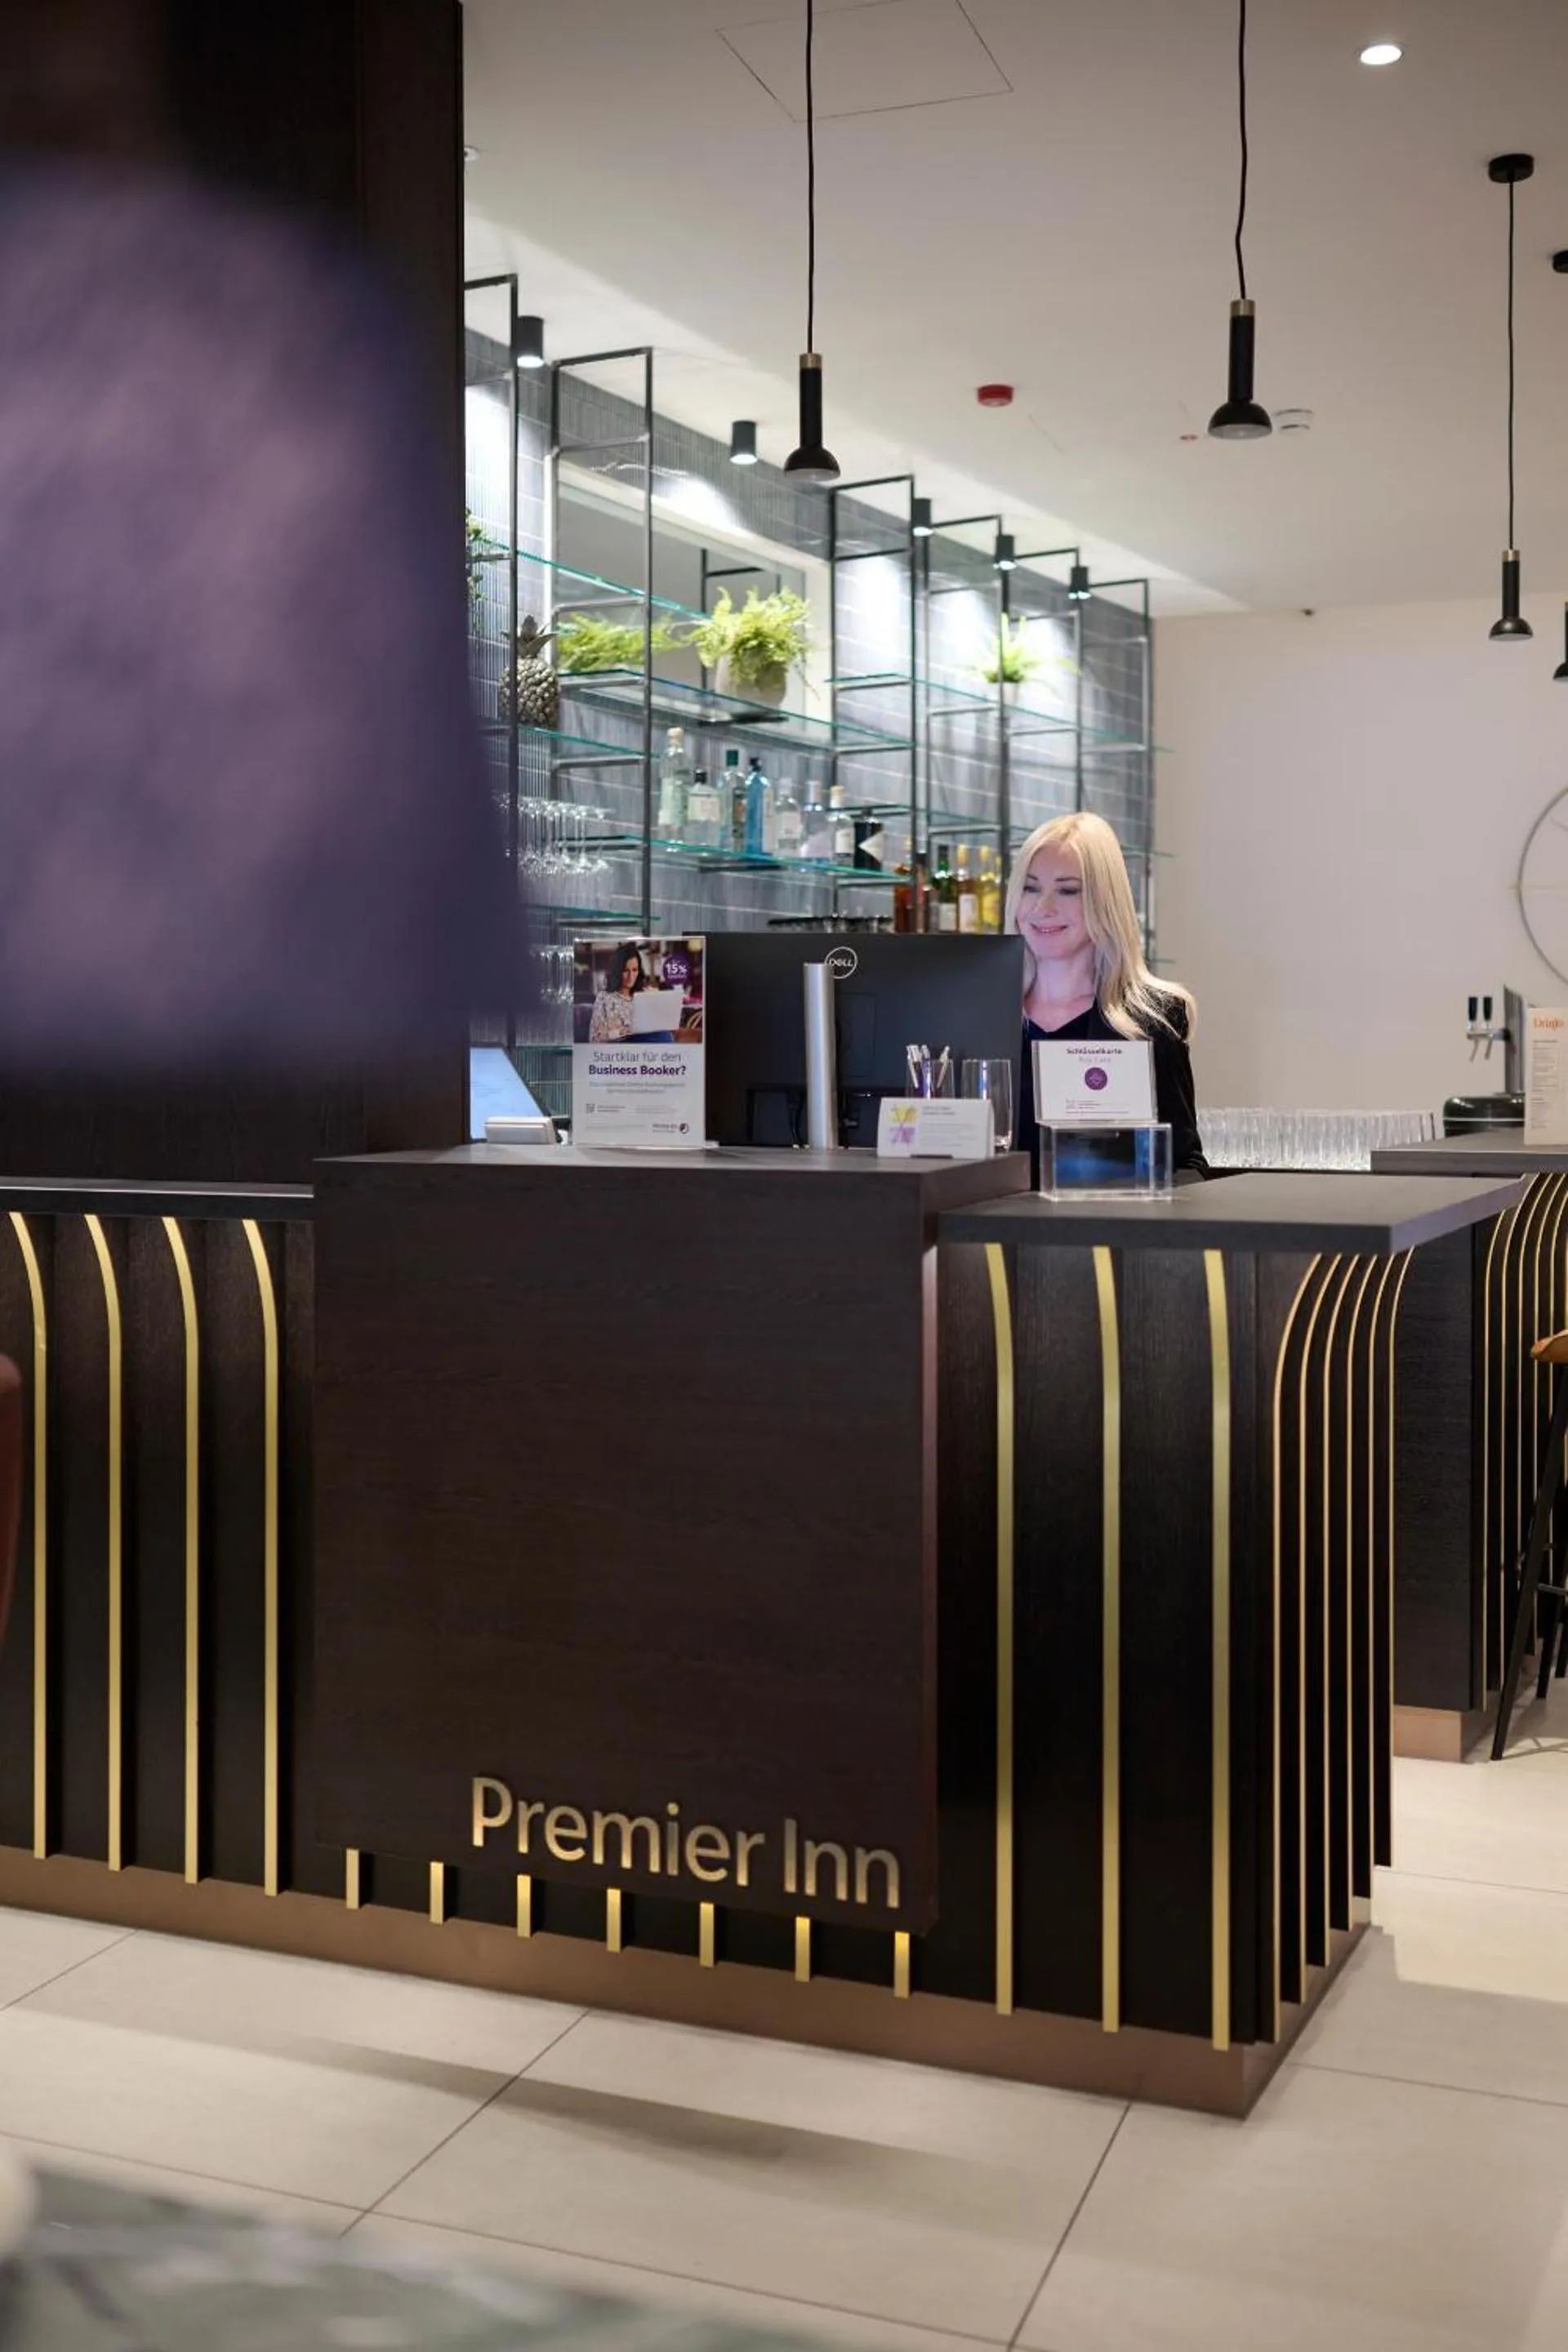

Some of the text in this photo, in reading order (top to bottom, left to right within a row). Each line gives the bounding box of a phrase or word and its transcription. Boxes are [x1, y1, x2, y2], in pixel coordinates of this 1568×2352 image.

[666, 963, 688, 974] 15%
[829, 958, 853, 967] DELL
[593, 1050, 682, 1062] Startklar für den
[589, 1064, 687, 1076] Business Booker?
[472, 1776, 899, 1909] Premier Inn
